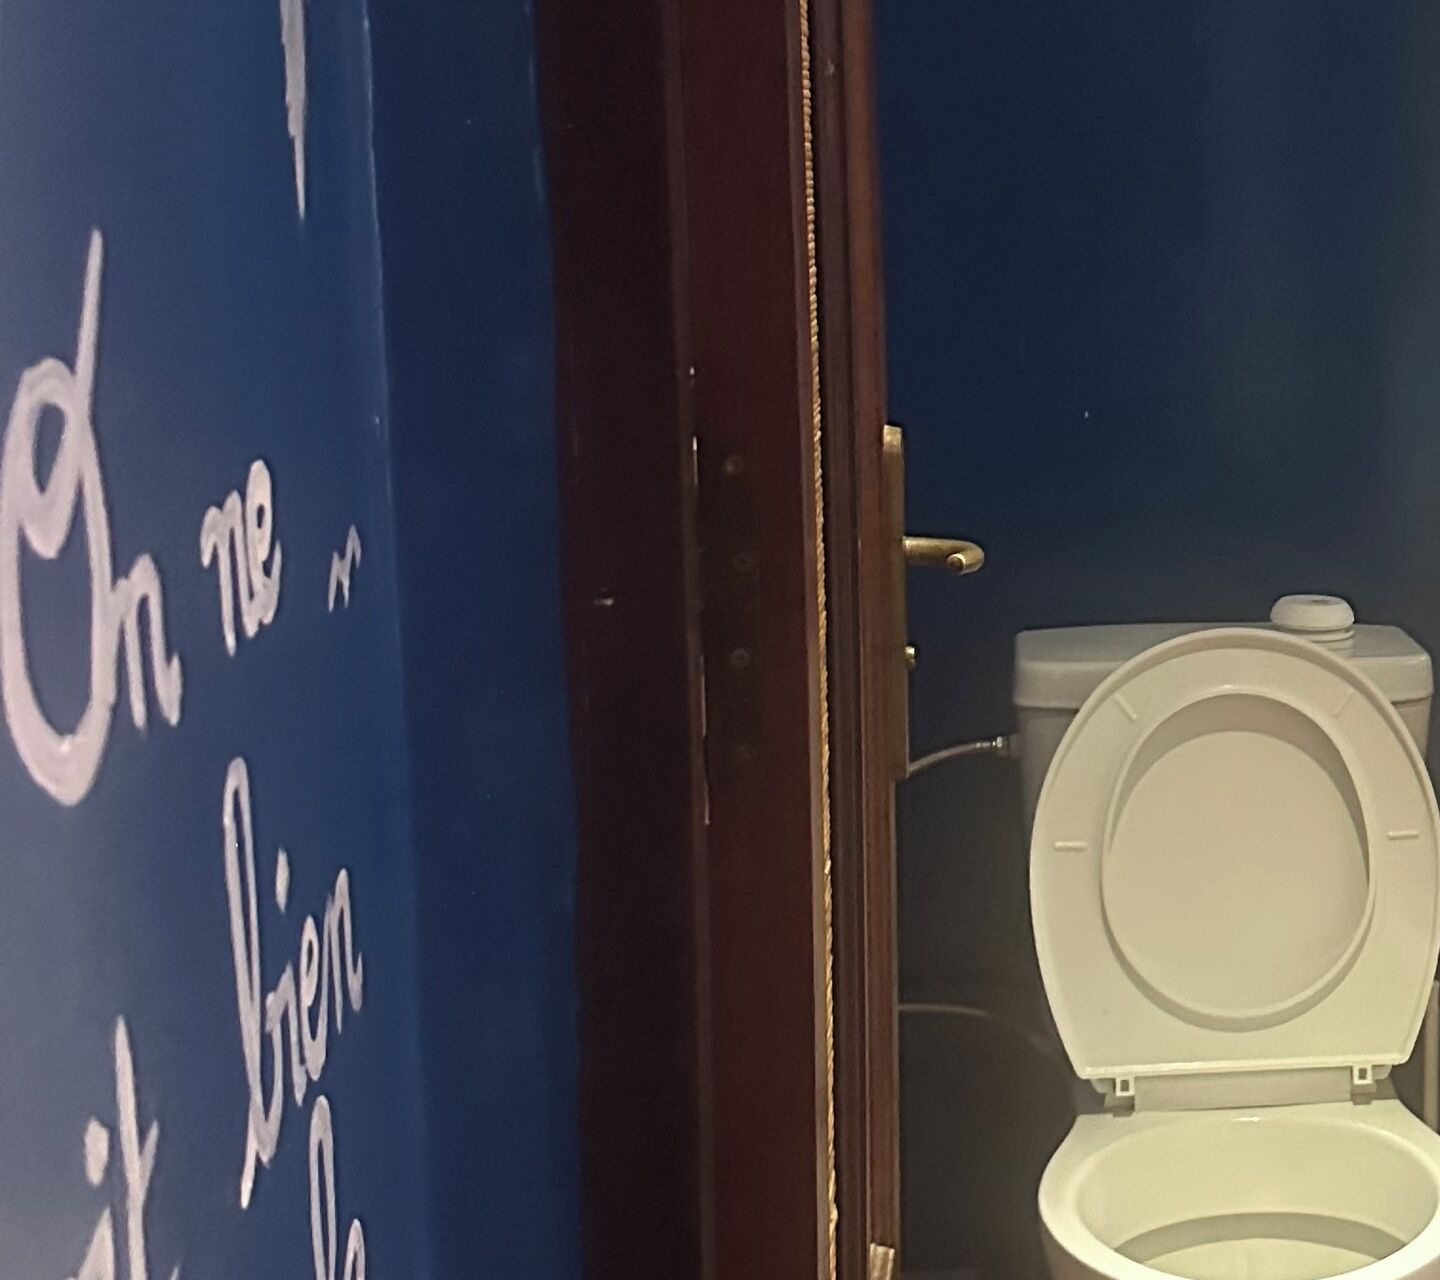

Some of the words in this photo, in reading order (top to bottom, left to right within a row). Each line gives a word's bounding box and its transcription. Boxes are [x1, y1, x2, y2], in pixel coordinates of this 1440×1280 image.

[0, 228, 182, 807] On
[202, 459, 281, 656] ne
[223, 756, 363, 1210] bien
